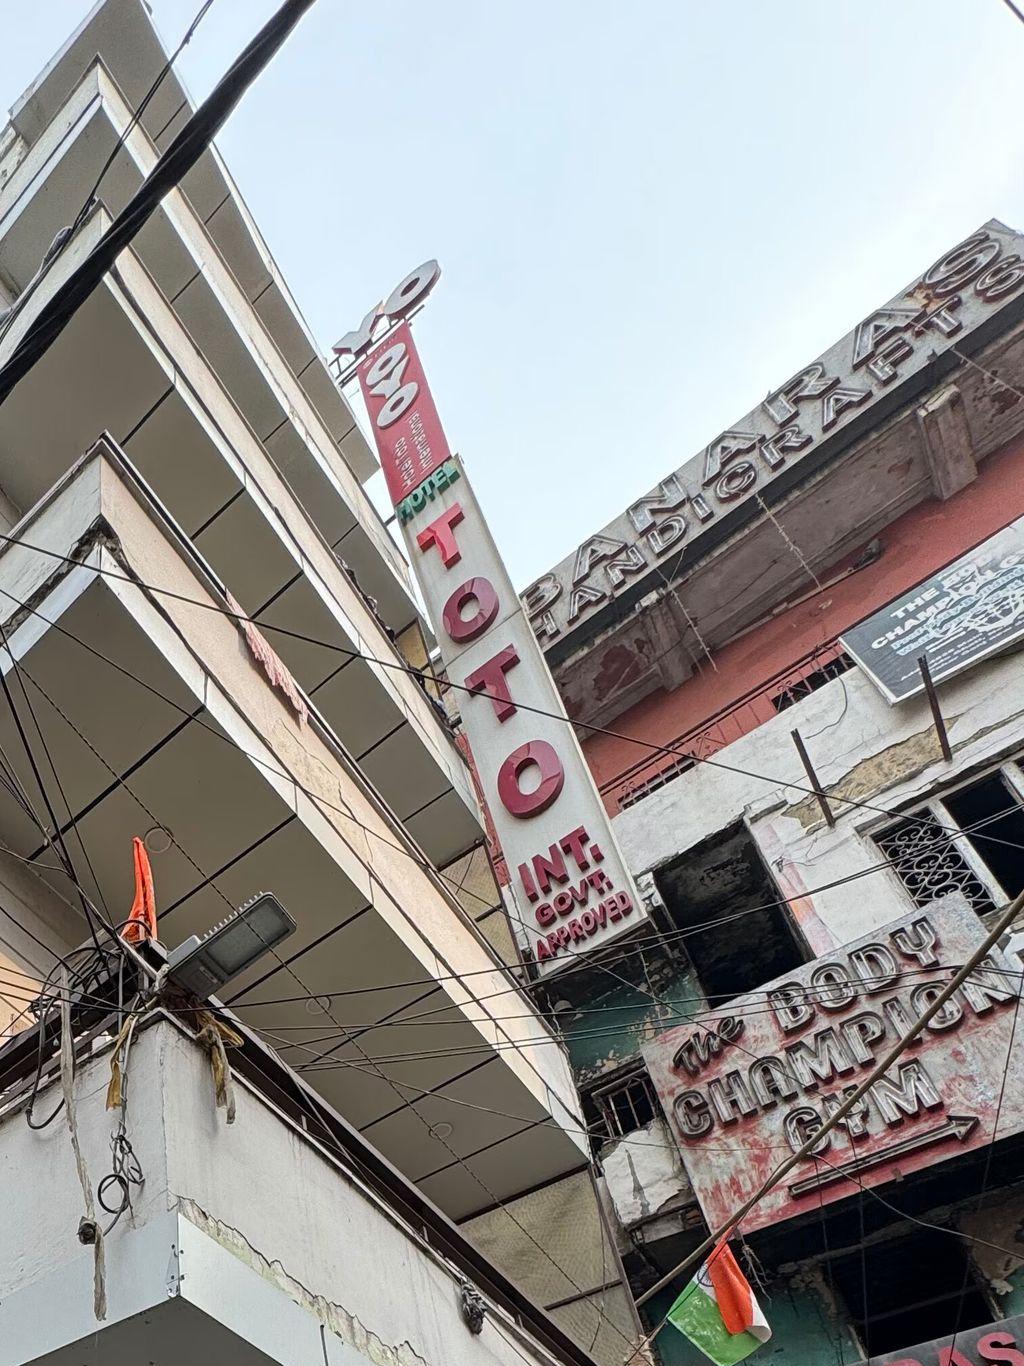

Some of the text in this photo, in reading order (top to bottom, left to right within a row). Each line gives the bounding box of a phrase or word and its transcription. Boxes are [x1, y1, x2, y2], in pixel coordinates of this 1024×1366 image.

[366, 342, 419, 429] OYO
[519, 231, 1001, 618] BANARAS
[396, 460, 461, 525] HOTEL
[889, 587, 940, 619] THE
[416, 503, 565, 819] TOTO
[537, 891, 634, 964] APPROVED
[767, 916, 940, 1034] BODY
[673, 957, 1017, 1139] CHAMPION
[783, 1057, 944, 1156] GYM
